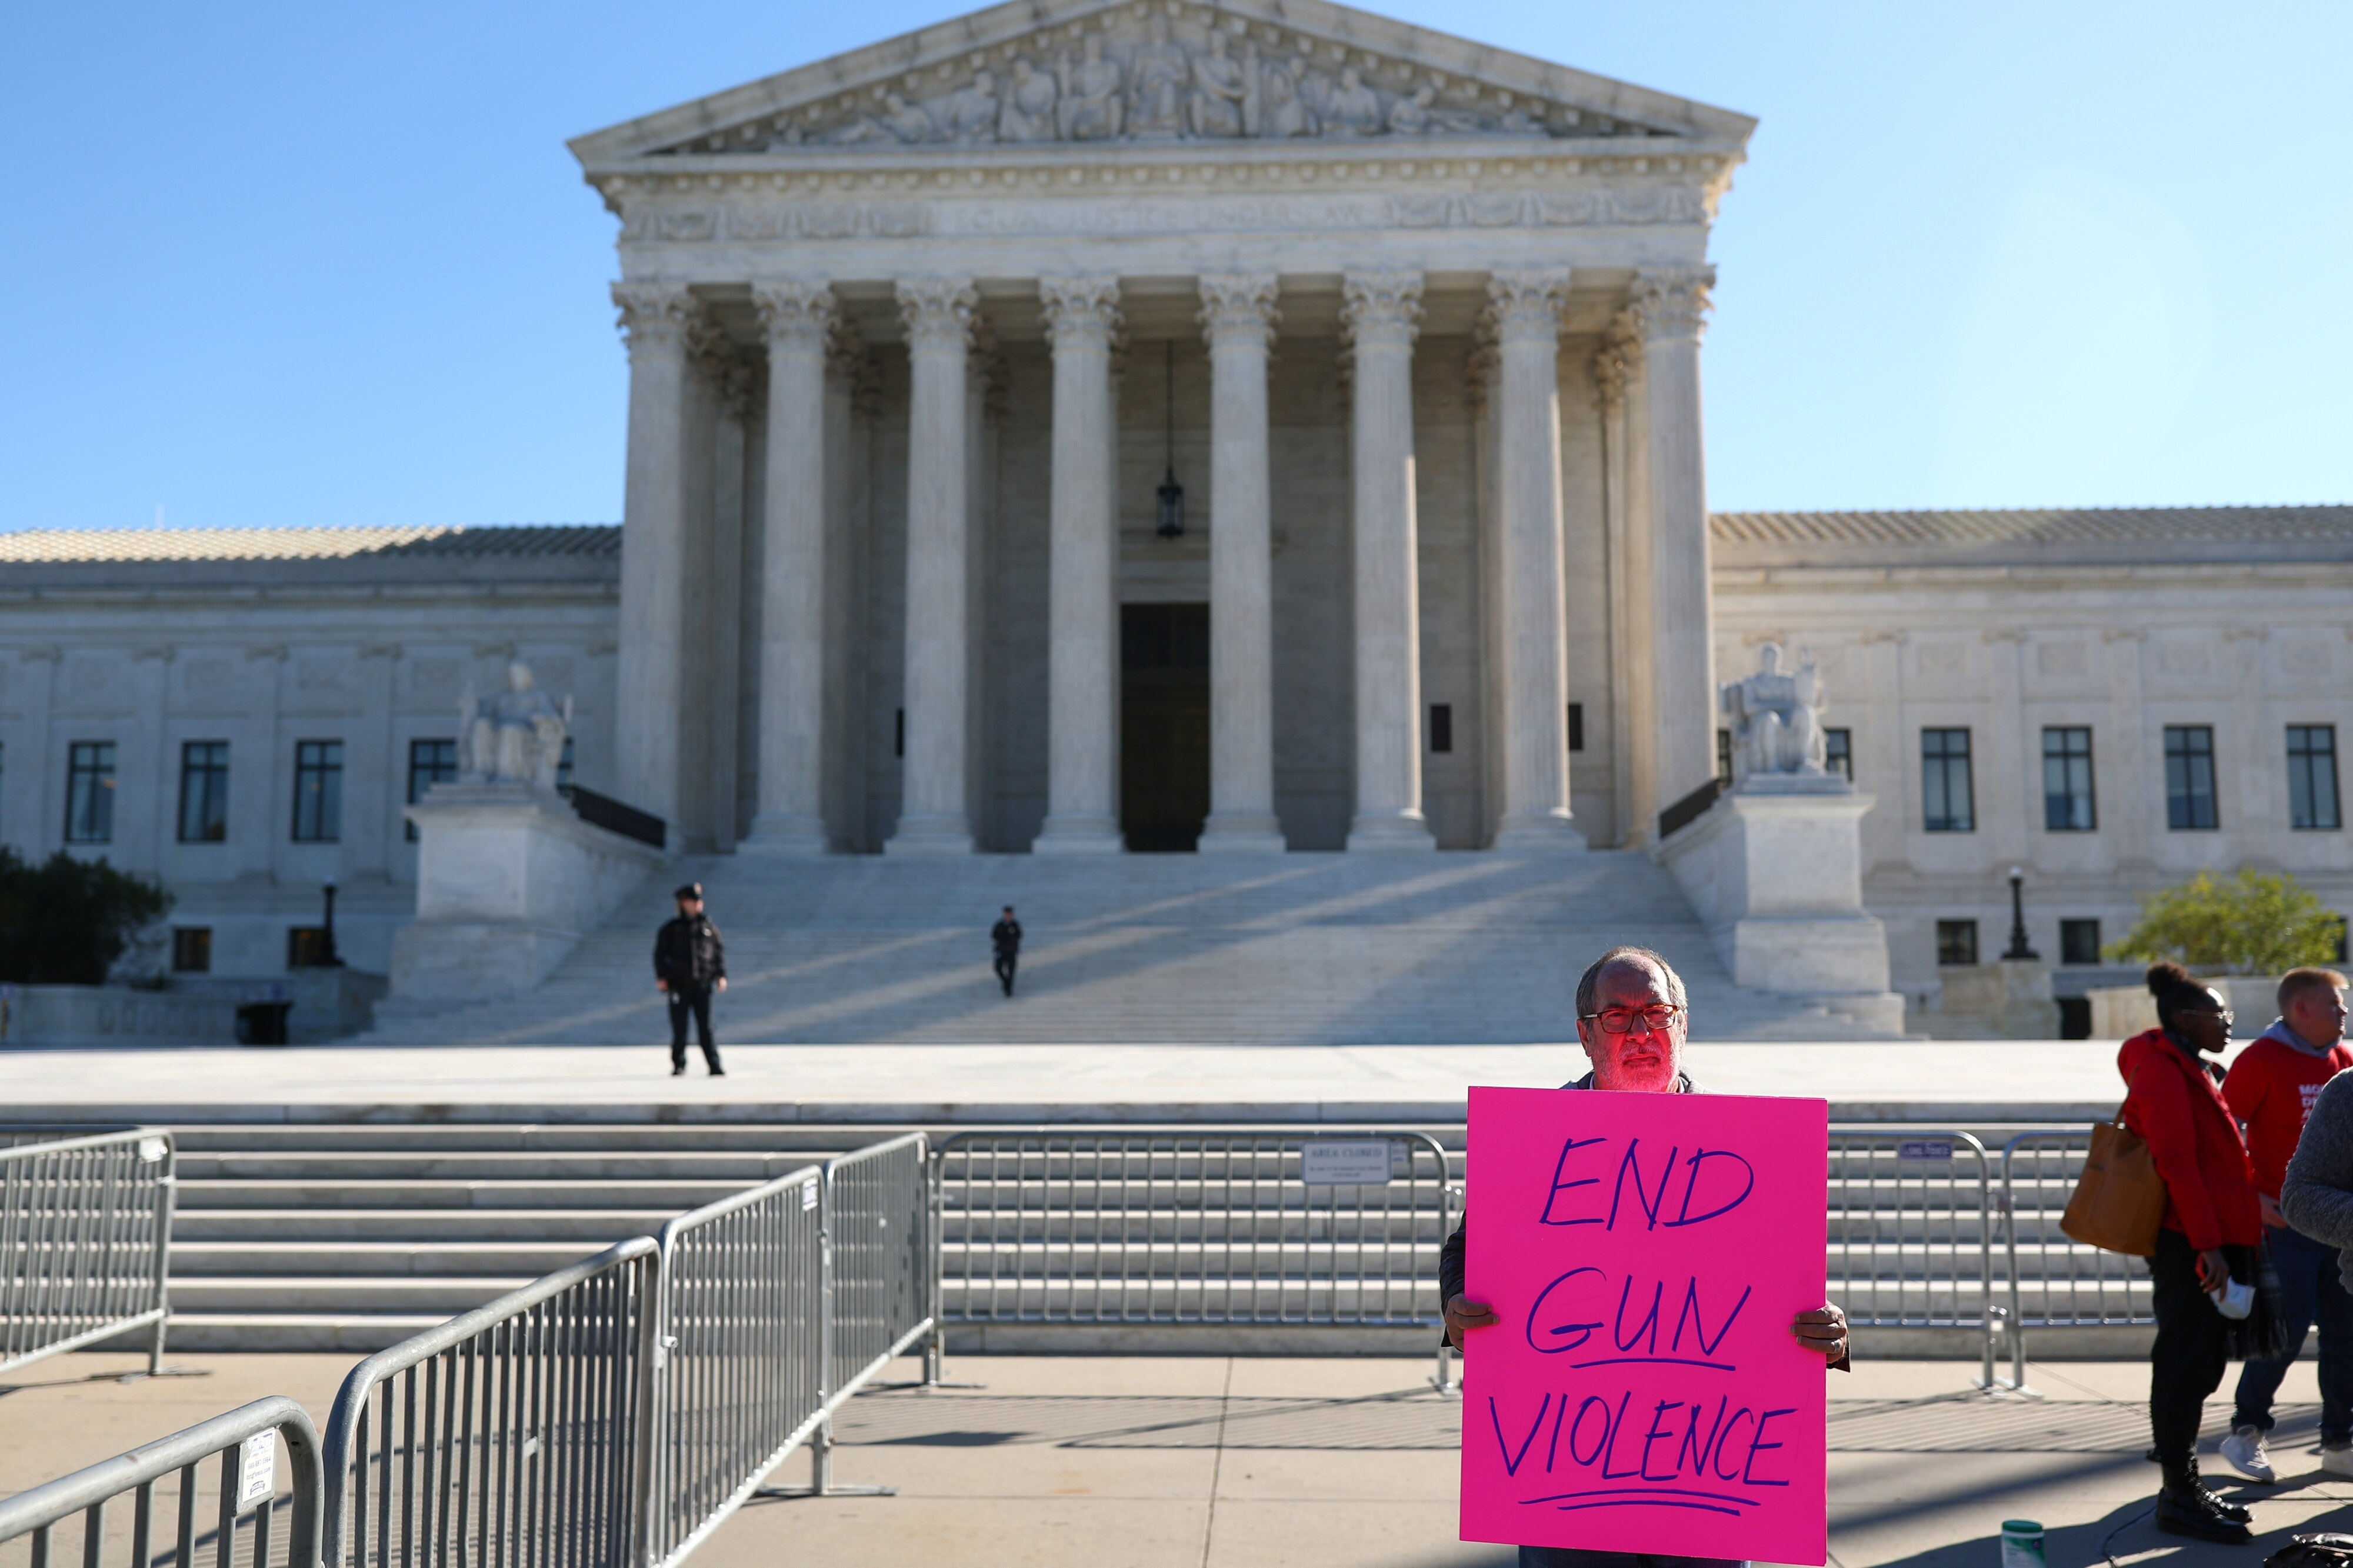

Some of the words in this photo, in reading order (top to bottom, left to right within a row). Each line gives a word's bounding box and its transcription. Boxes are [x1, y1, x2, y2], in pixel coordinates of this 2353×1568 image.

[1539, 1138, 1754, 1230] END
[1527, 1267, 1751, 1356] GUN
[1489, 1392, 1796, 1486] VIOLENCE
